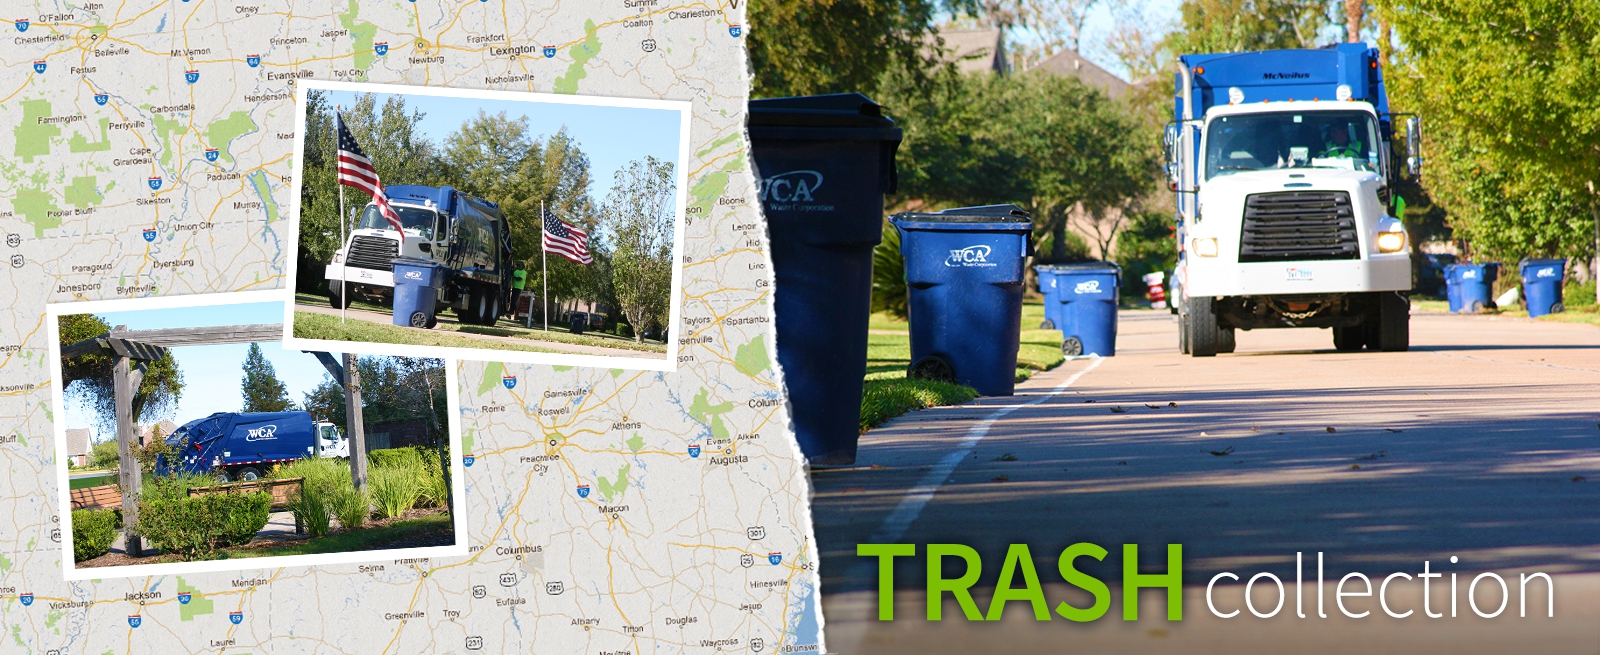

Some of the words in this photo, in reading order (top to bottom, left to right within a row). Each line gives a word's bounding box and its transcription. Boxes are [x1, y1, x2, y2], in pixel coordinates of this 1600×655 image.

[83, 2, 104, 10] Alton
[668, 8, 716, 20] Charleston
[319, 28, 348, 39] Jasper
[466, 33, 505, 43] Frankfort
[14, 34, 65, 45] Chesterfield
[270, 35, 307, 45] Princeton
[94, 47, 130, 57] Belleville
[489, 44, 535, 57] Lexington
[408, 54, 445, 65] Newburg
[70, 66, 97, 75] Festus
[267, 69, 314, 81] Evansville
[348, 68, 365, 78] City
[485, 74, 535, 84] Nicholasville
[1263, 72, 1310, 80] McNeilus
[244, 92, 287, 102] Henderson
[150, 103, 196, 113] Carbondale
[38, 114, 82, 125] Farmington
[109, 120, 145, 130] Perryville
[129, 147, 151, 156] Cape
[113, 156, 153, 166] Girardeau
[206, 172, 241, 182] Paducah
[136, 197, 171, 206] Sikeston
[233, 201, 261, 210] Murray
[719, 196, 745, 206] Boone
[47, 209, 72, 218] Poplar
[74, 207, 93, 216] Bluff
[686, 205, 702, 214] son
[792, 203, 835, 212] Corporation
[174, 223, 197, 232] Union
[197, 221, 215, 230] City
[950, 249, 986, 262] WCA
[72, 263, 112, 273] Paragould
[153, 258, 194, 269] Dyersburg
[56, 282, 101, 294] Jonesboro
[116, 284, 156, 295] Blytheville
[683, 316, 711, 326] Taylors
[543, 388, 588, 399] Gainesville
[481, 404, 506, 413] Rome
[537, 406, 570, 417] Roswell
[611, 421, 642, 431] Athens
[706, 437, 732, 446] Evans
[737, 432, 760, 442] Aiken
[520, 453, 560, 463] Peachtree
[709, 454, 748, 466] Augusta
[533, 463, 549, 473] City
[598, 505, 630, 514] Macon
[495, 544, 543, 556] Columbus
[358, 564, 385, 574] Selma
[232, 579, 268, 588] Meridian
[750, 579, 788, 588] Hinesville
[123, 590, 162, 601] Jackson
[49, 601, 89, 610] Vicksburg
[495, 597, 526, 607] Eufaula
[739, 603, 762, 612] Jesup
[384, 610, 425, 620] Greenville
[442, 609, 461, 619] Troy
[571, 617, 600, 627] Albany
[665, 616, 698, 626] Douglas
[622, 625, 644, 633] Tifton
[210, 638, 236, 647] Laurel
[700, 638, 739, 648] Waycross
